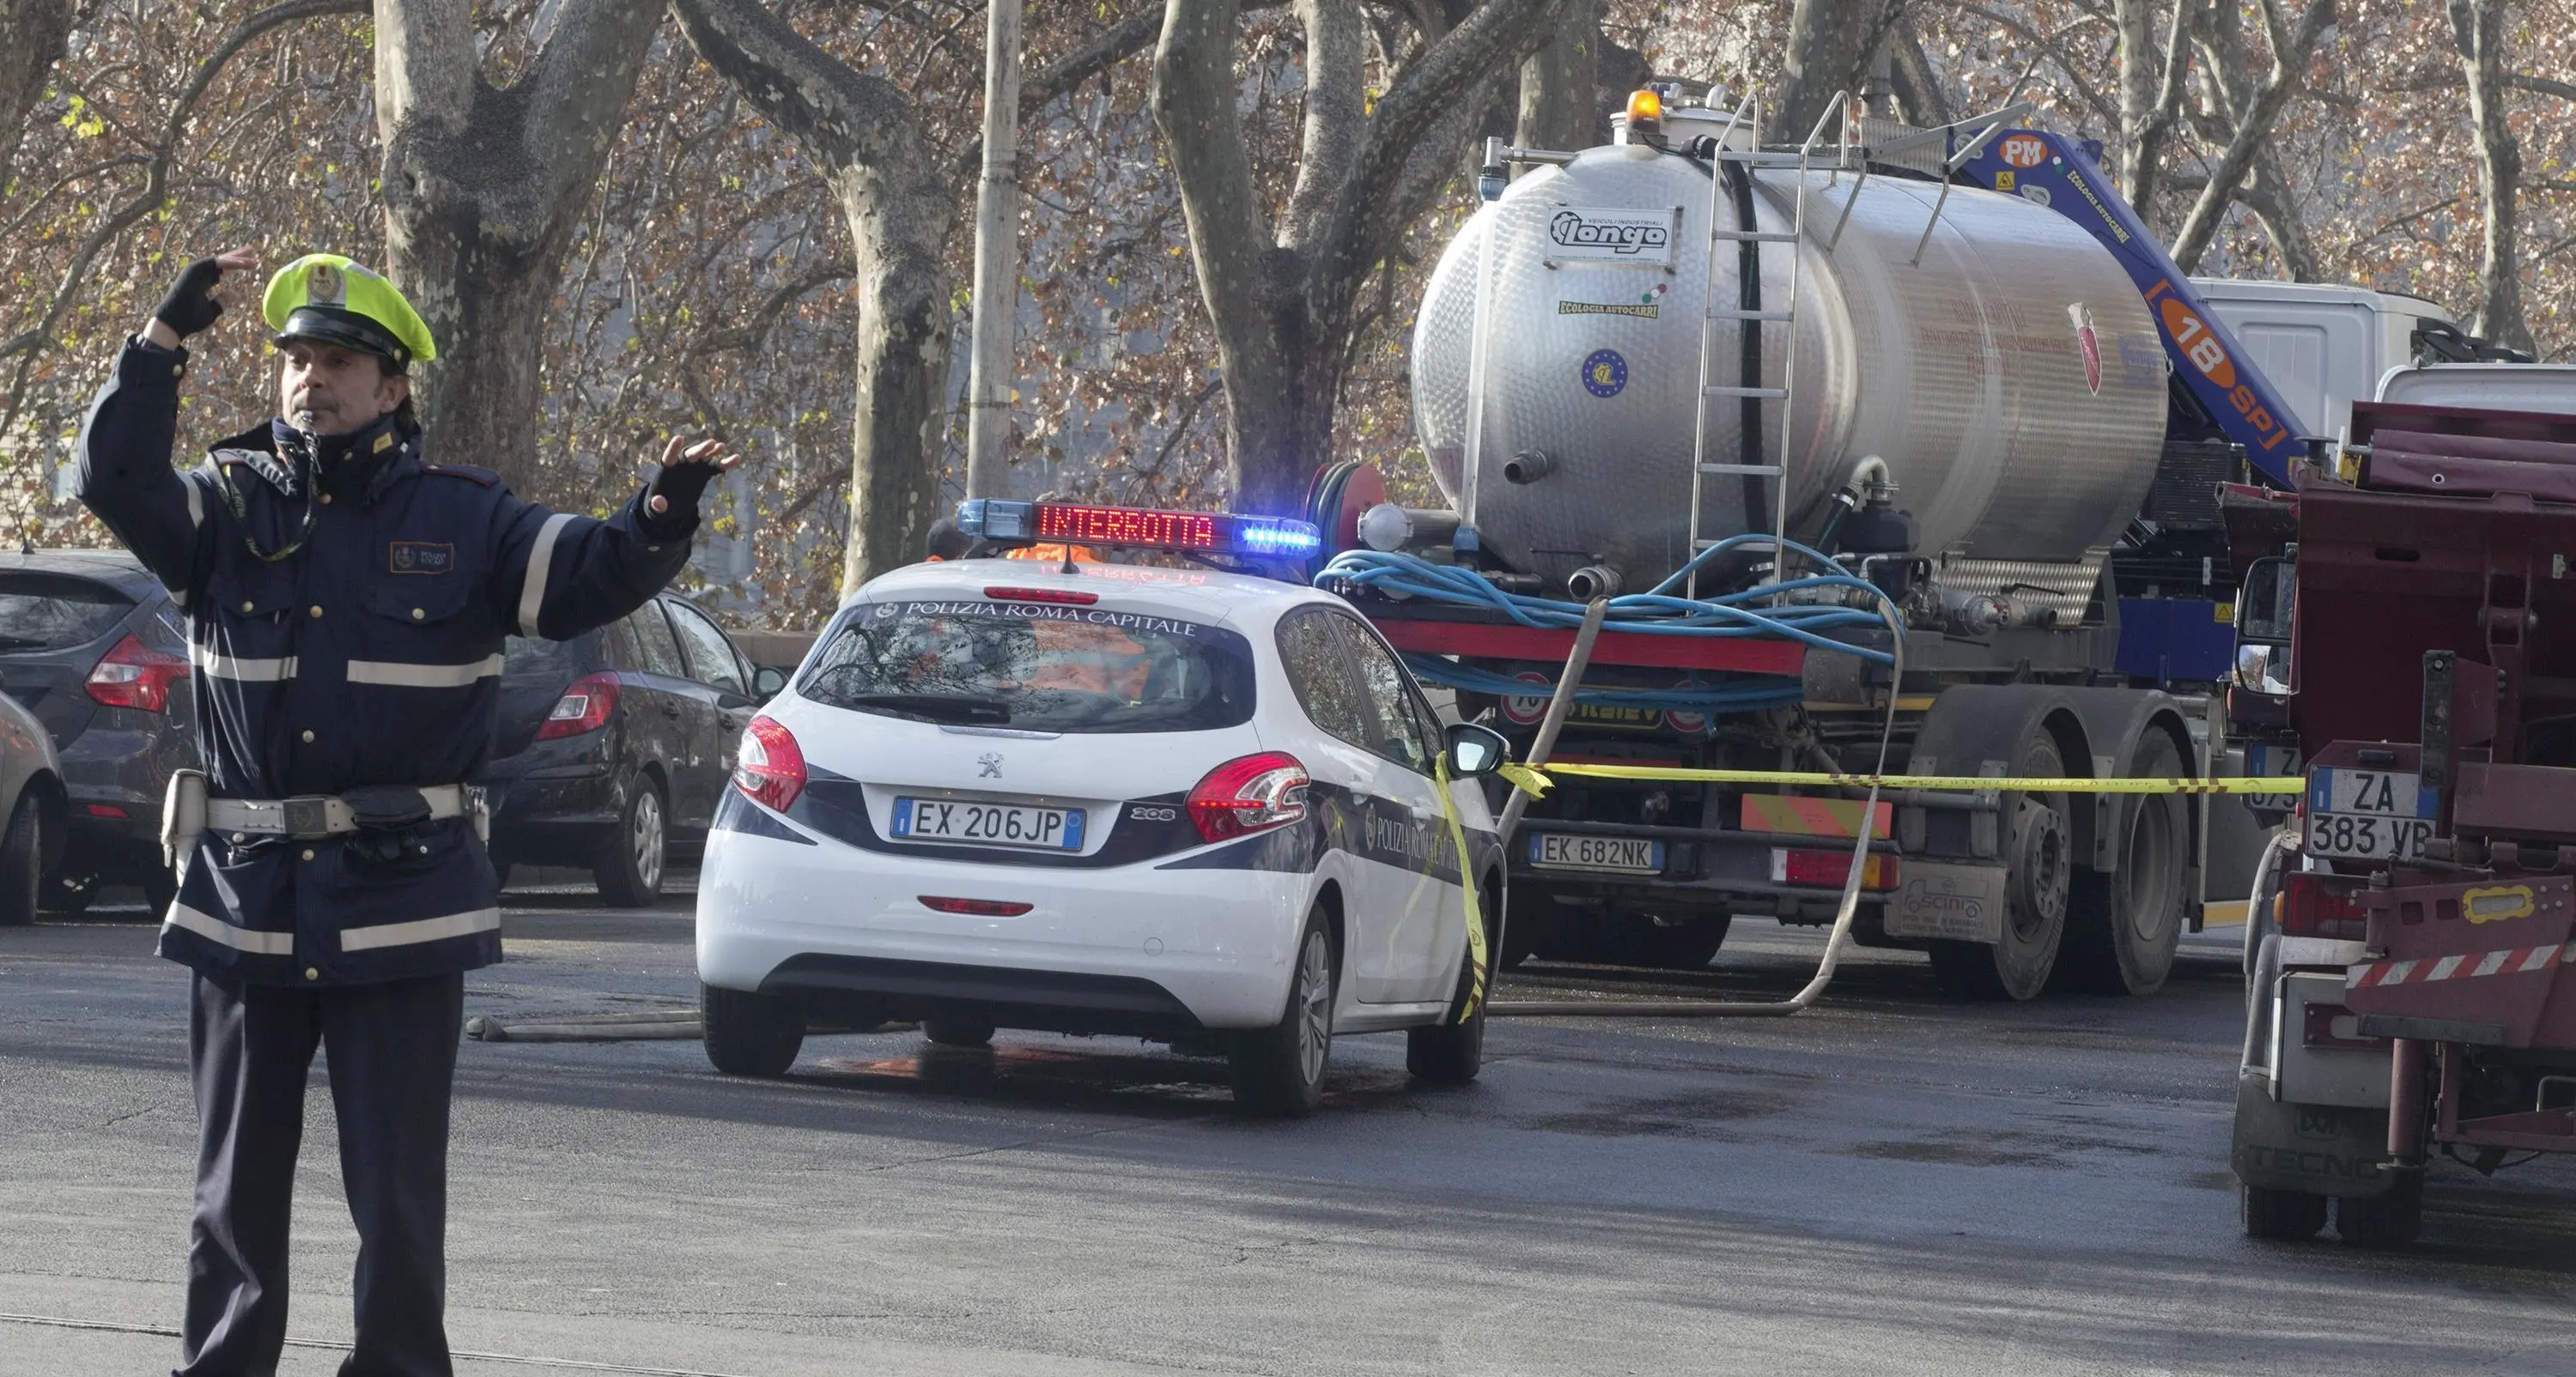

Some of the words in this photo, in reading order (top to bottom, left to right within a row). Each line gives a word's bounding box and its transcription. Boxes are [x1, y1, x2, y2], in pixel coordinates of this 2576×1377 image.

[2005, 141, 2042, 165] PM
[2067, 170, 2097, 206] ECOLOGIA
[2095, 204, 2130, 244] AUTOCARRI
[1560, 302, 1605, 313] ECOLOGIA
[1606, 306, 1658, 318] AUTOCARRI
[1042, 507, 1212, 547] INTERROTTA
[907, 602, 997, 616] POLIZIA
[1005, 604, 1079, 621] ROMA
[1087, 611, 1196, 638] CAPITALE
[2354, 773, 2394, 811] ZA
[915, 804, 955, 834] EX
[964, 807, 1062, 842] 206JP
[1130, 807, 1176, 822] 208
[1377, 817, 1410, 855] POLIZIA
[1546, 837, 1571, 861] EK
[1580, 840, 1649, 866] 682NK
[2313, 815, 2377, 854] 383
